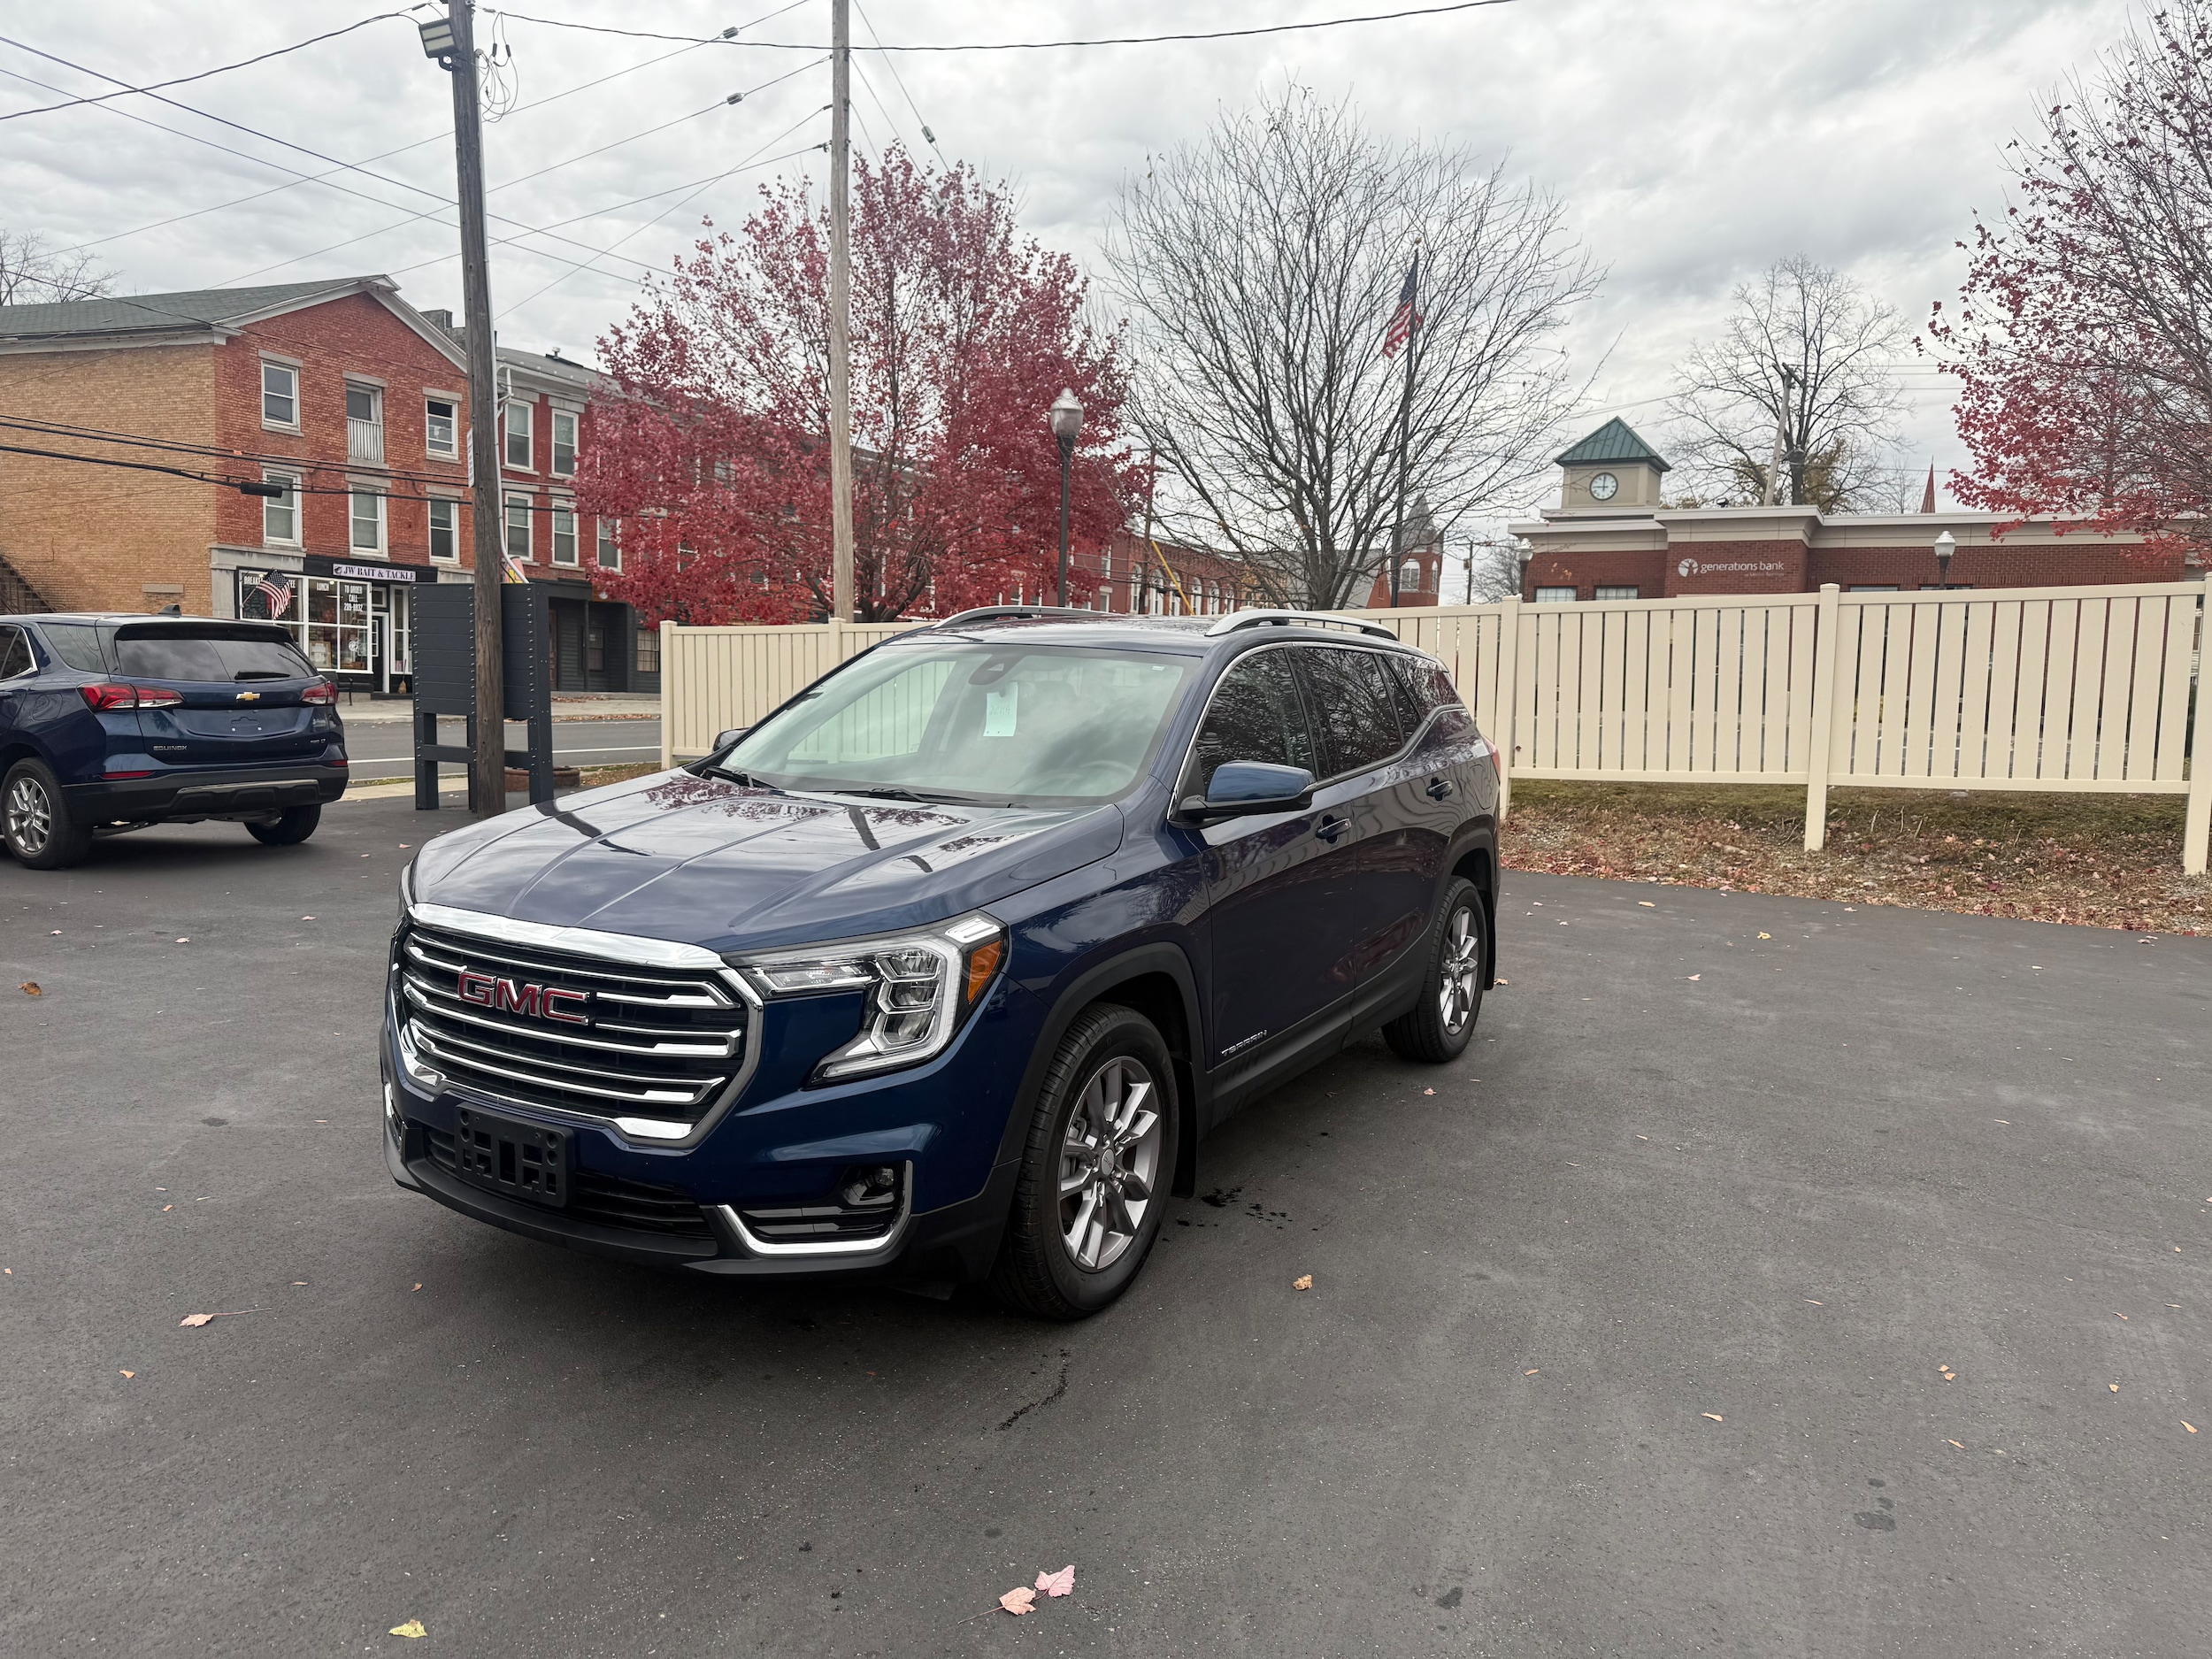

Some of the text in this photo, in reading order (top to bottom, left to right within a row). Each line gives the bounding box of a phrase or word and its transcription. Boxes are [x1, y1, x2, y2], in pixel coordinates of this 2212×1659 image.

[357, 567, 376, 577] BAIT
[377, 569, 384, 578] &
[386, 569, 415, 580] TACKLE
[1700, 561, 1785, 574] generations bank
[349, 594, 358, 603] CALL
[457, 971, 590, 1025] GMC
